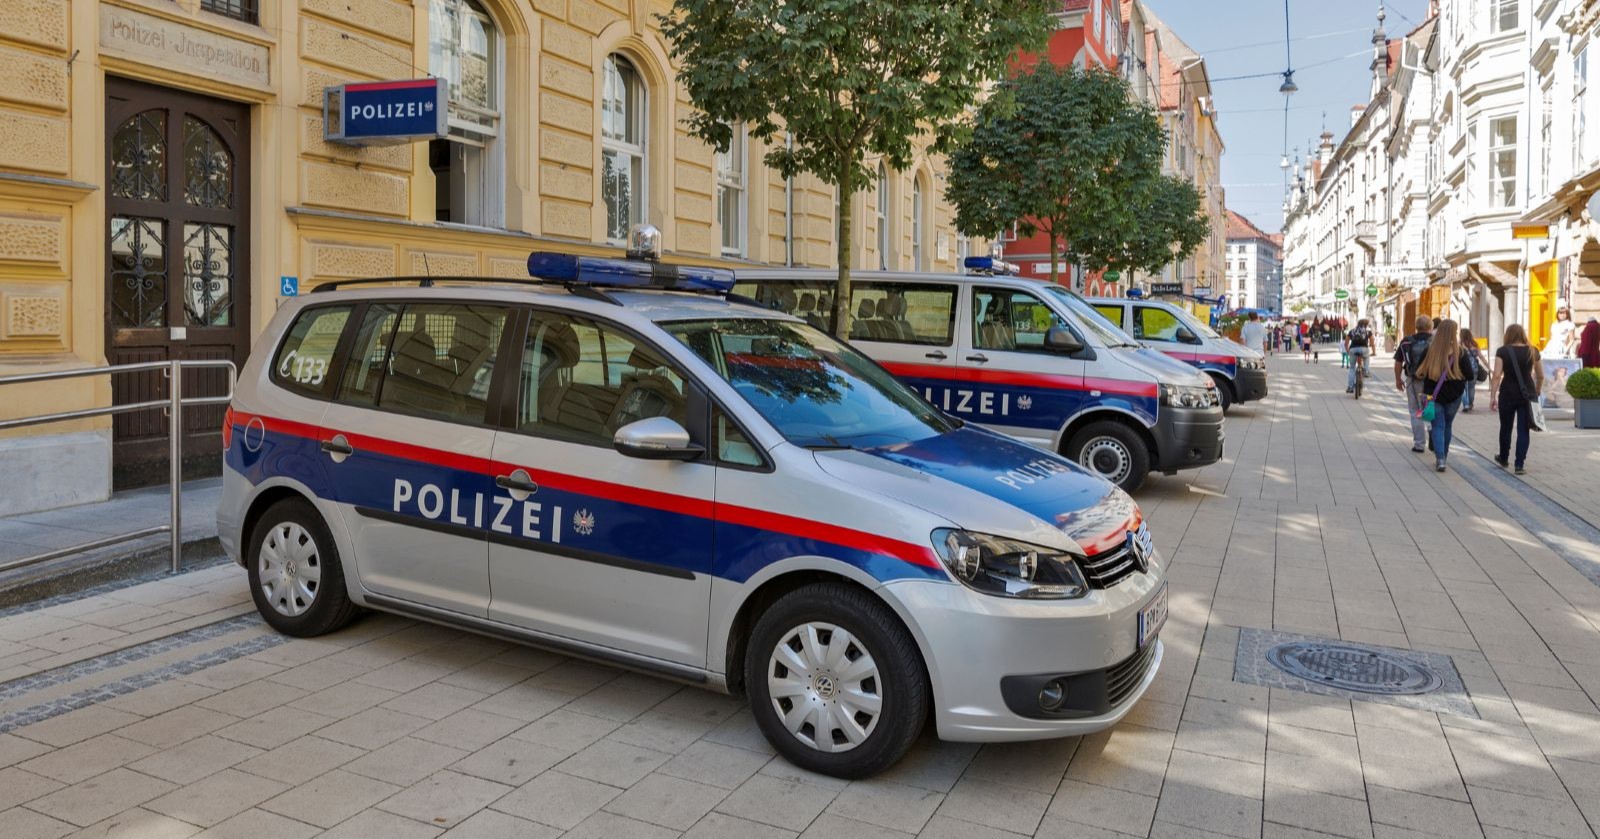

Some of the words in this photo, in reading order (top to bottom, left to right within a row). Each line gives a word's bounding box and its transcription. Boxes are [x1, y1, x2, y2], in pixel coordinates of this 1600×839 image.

[351, 101, 423, 120] POLIZEI
[295, 356, 326, 385] 133
[393, 478, 562, 543] POLIZEI
